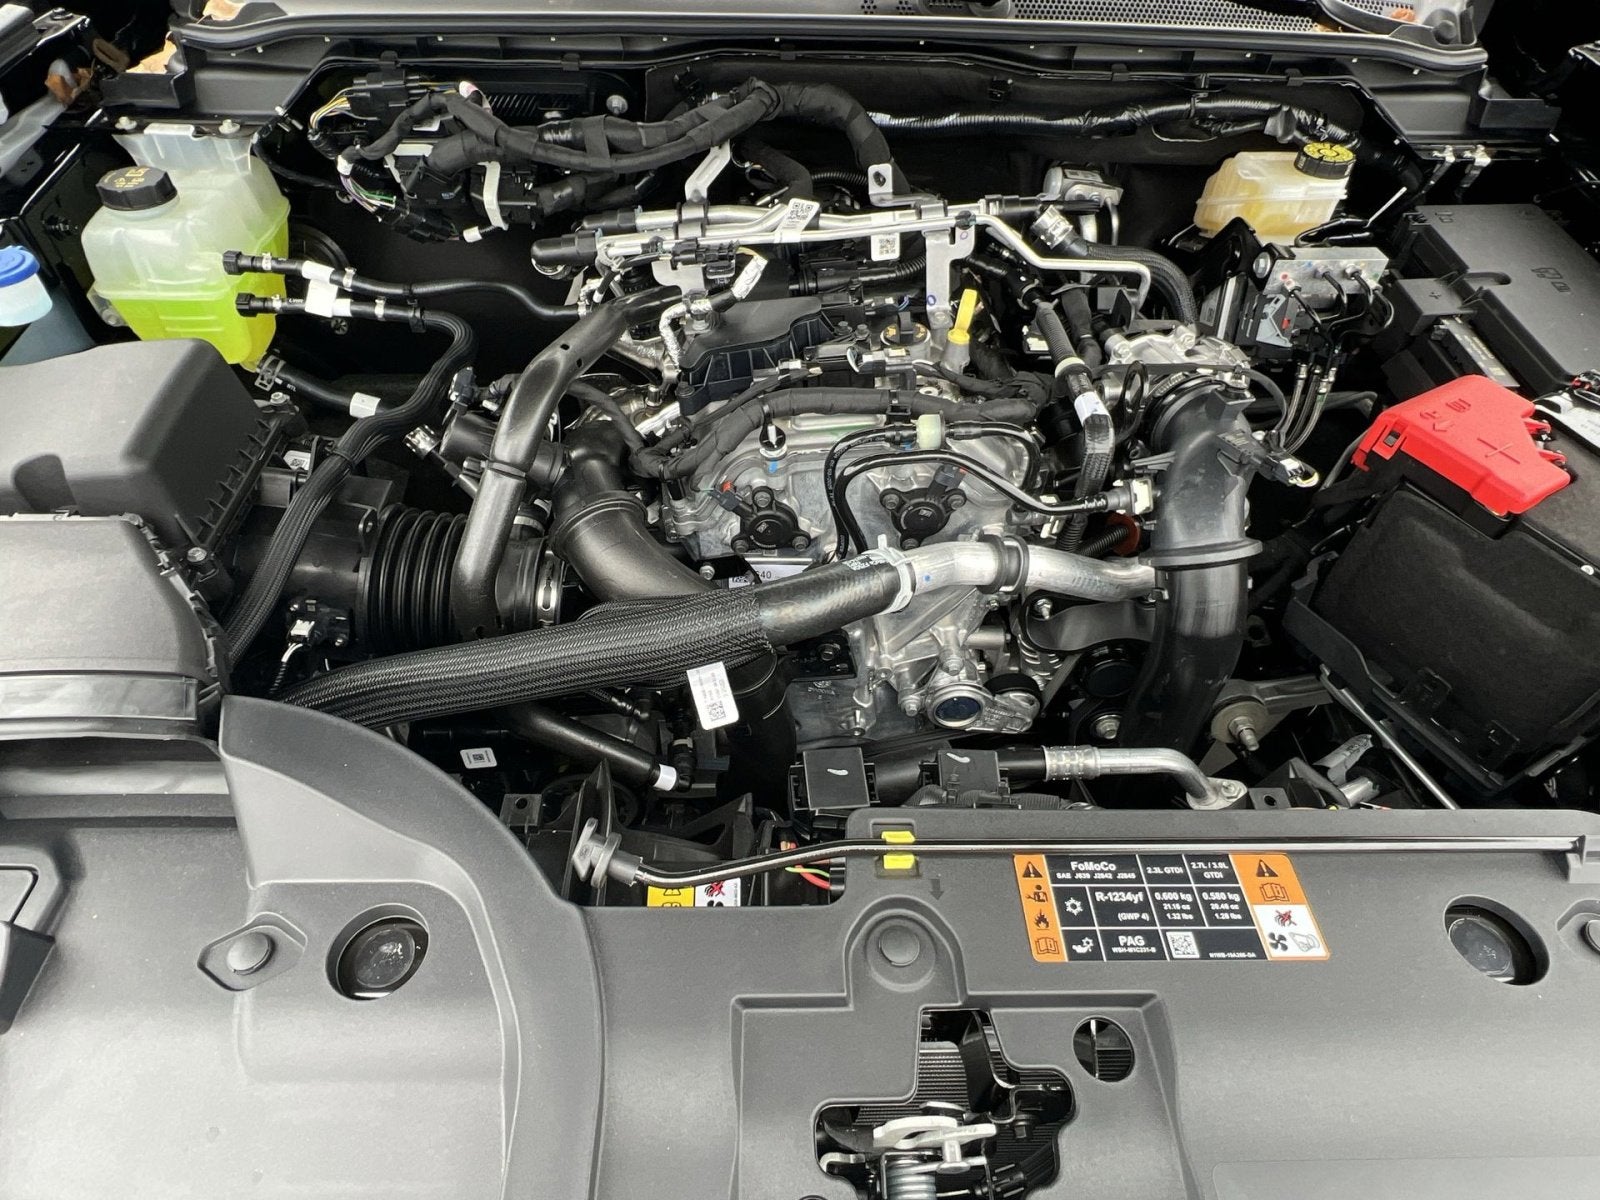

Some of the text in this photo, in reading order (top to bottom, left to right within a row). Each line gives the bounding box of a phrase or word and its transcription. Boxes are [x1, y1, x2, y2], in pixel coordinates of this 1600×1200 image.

[1070, 861, 1117, 871] FoMoCo
[1203, 871, 1224, 879] GTDI
[1094, 891, 1144, 904] R-1234yf
[1154, 892, 1193, 902] 0.600 kg
[1202, 892, 1241, 902] 0.580 kg
[1117, 912, 1150, 922] (GWP 4)
[1166, 912, 1194, 920] 1.32 lbs
[1229, 912, 1242, 920] lbs
[1118, 935, 1145, 946] PAG
